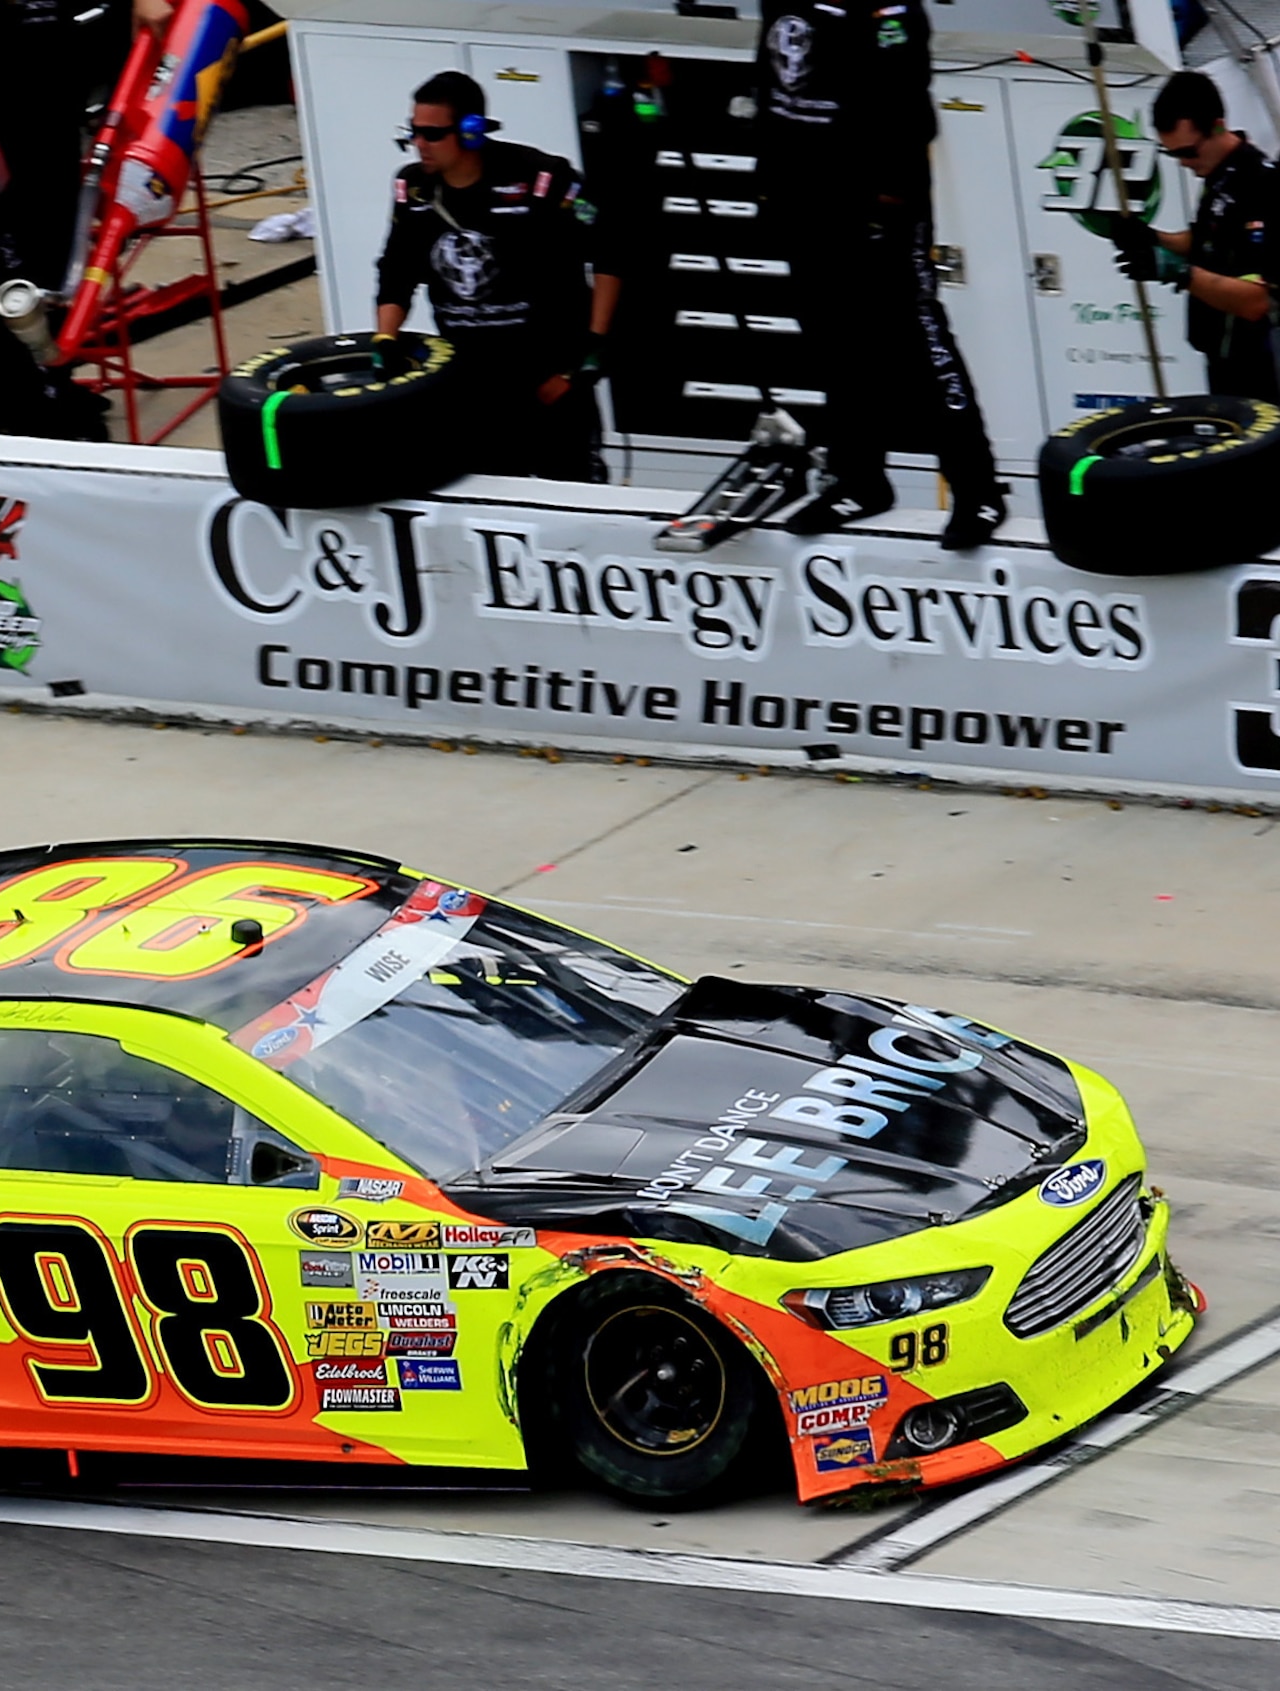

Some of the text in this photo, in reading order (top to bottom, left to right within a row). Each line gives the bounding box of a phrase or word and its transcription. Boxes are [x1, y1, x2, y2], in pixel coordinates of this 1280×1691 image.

[210, 498, 1143, 661] C&J Energy Services
[257, 644, 1127, 755] Competitive Horsepower
[364, 949, 411, 984] WISE
[260, 1030, 293, 1054] Ford
[658, 1004, 1015, 1248] LEE BRICE
[696, 1087, 781, 1152] DANCE
[357, 1177, 403, 1196] NASCAR
[1048, 1165, 1099, 1201] Ford
[312, 1223, 339, 1235] Sprint
[445, 1226, 501, 1247] Holley
[360, 1253, 415, 1271] Mobil
[380, 1288, 441, 1301] freescale
[325, 1303, 363, 1315] Auto
[380, 1303, 442, 1316] LINCOLN
[324, 1314, 373, 1327] Meter
[394, 1317, 450, 1328] WELDERS
[308, 1332, 384, 1356] JEGS
[391, 1334, 453, 1348] Duralast
[890, 1322, 948, 1373] 98
[315, 1363, 385, 1380] Edelbrock
[418, 1365, 455, 1375] SHERWIN
[419, 1375, 457, 1384] WILLIAMS
[322, 1387, 396, 1409] FLOWMASTER
[792, 1375, 883, 1408] MOOG
[801, 1405, 866, 1431] COMP
[817, 1440, 870, 1460] SUNOCO
